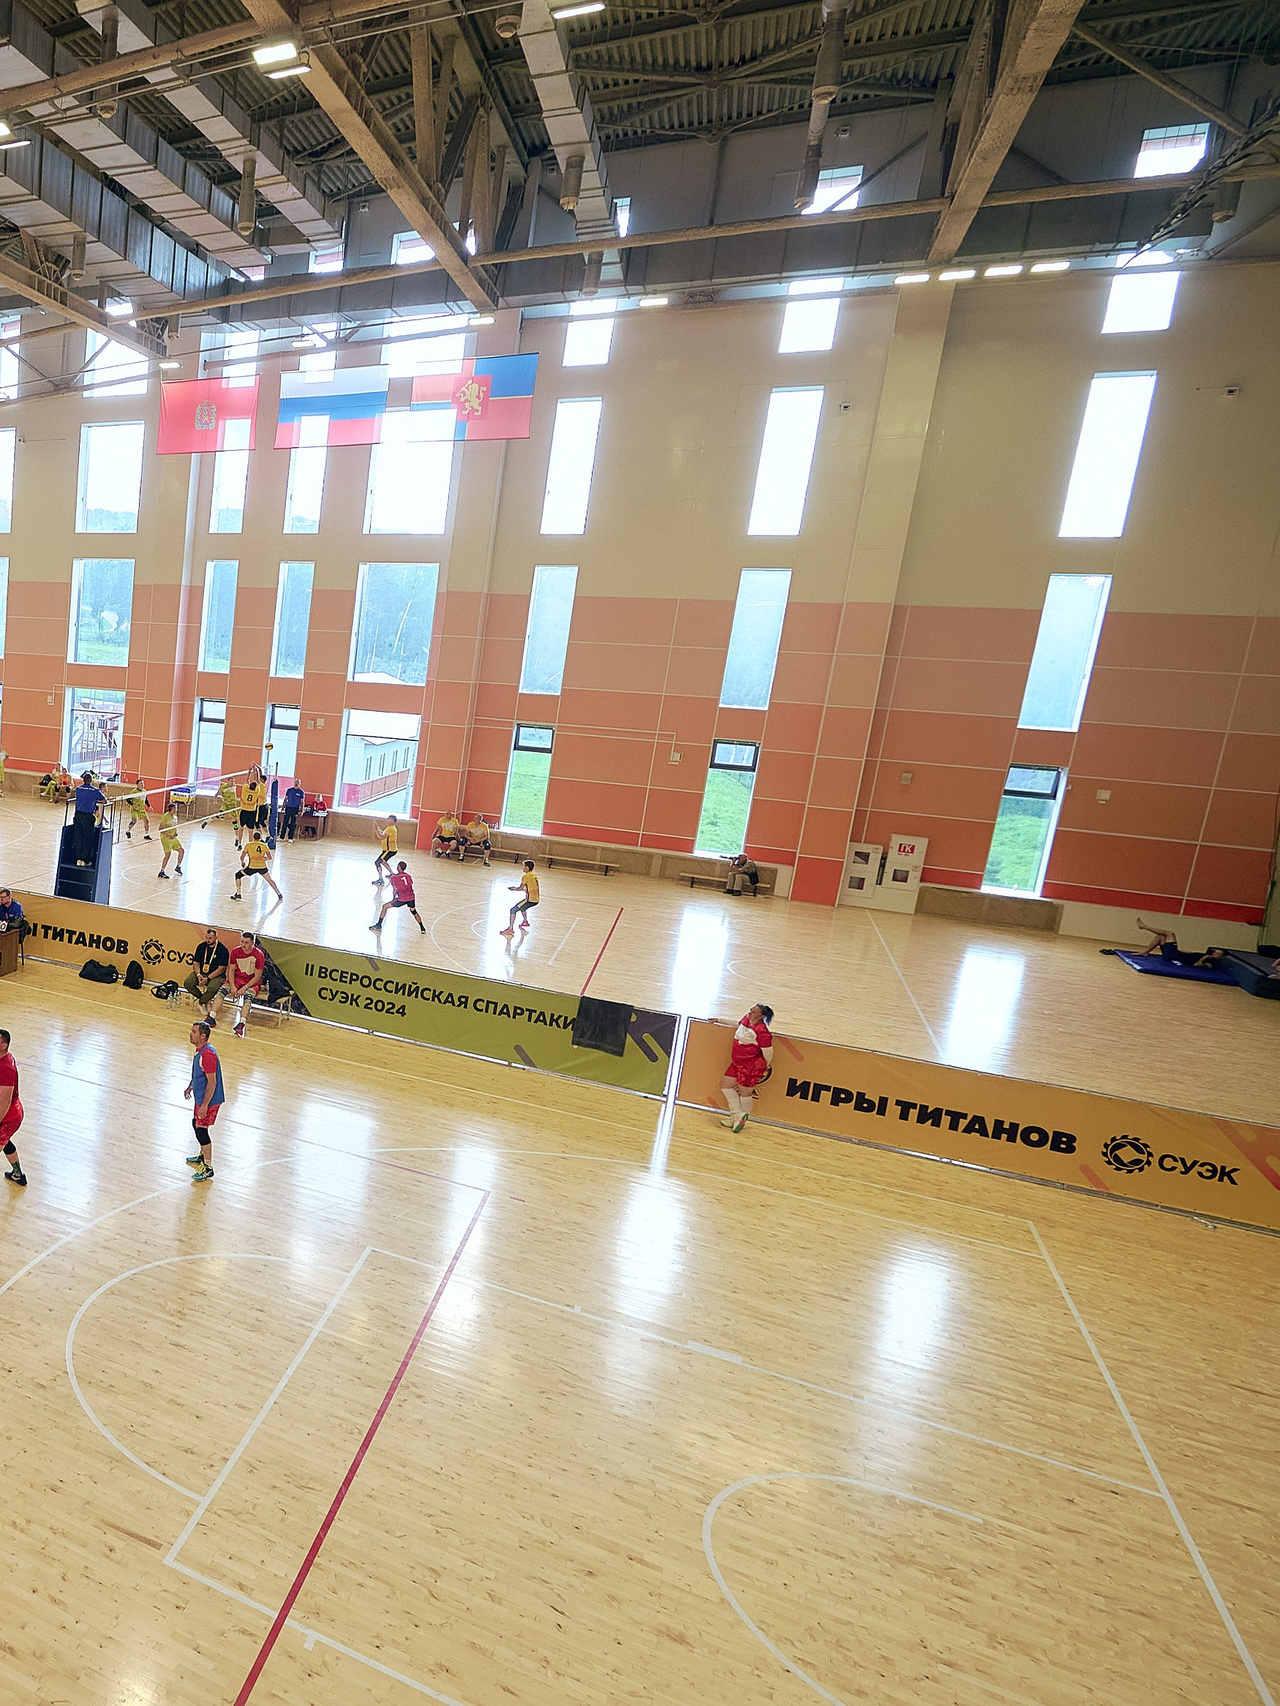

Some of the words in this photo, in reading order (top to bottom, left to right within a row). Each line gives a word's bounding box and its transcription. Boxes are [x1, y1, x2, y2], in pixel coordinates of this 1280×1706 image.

[247, 794, 253, 802] 8
[256, 845, 262, 854] 4
[900, 844, 912, 853] ПК
[401, 876, 408, 886] 1
[41, 924, 129, 955] ТИТАНОВ
[167, 949, 195, 966] СУЭ
[317, 965, 470, 1010] ВСЕРОССИЙСКАЯ
[472, 997, 578, 1031] СПАРТАКИ
[318, 986, 361, 1007] СУЭК
[363, 996, 407, 1018] 2024
[785, 1078, 890, 1117] ИГРЫ
[893, 1098, 1078, 1155] ТИТАНОВ
[1158, 1151, 1241, 1187] СУЭК
